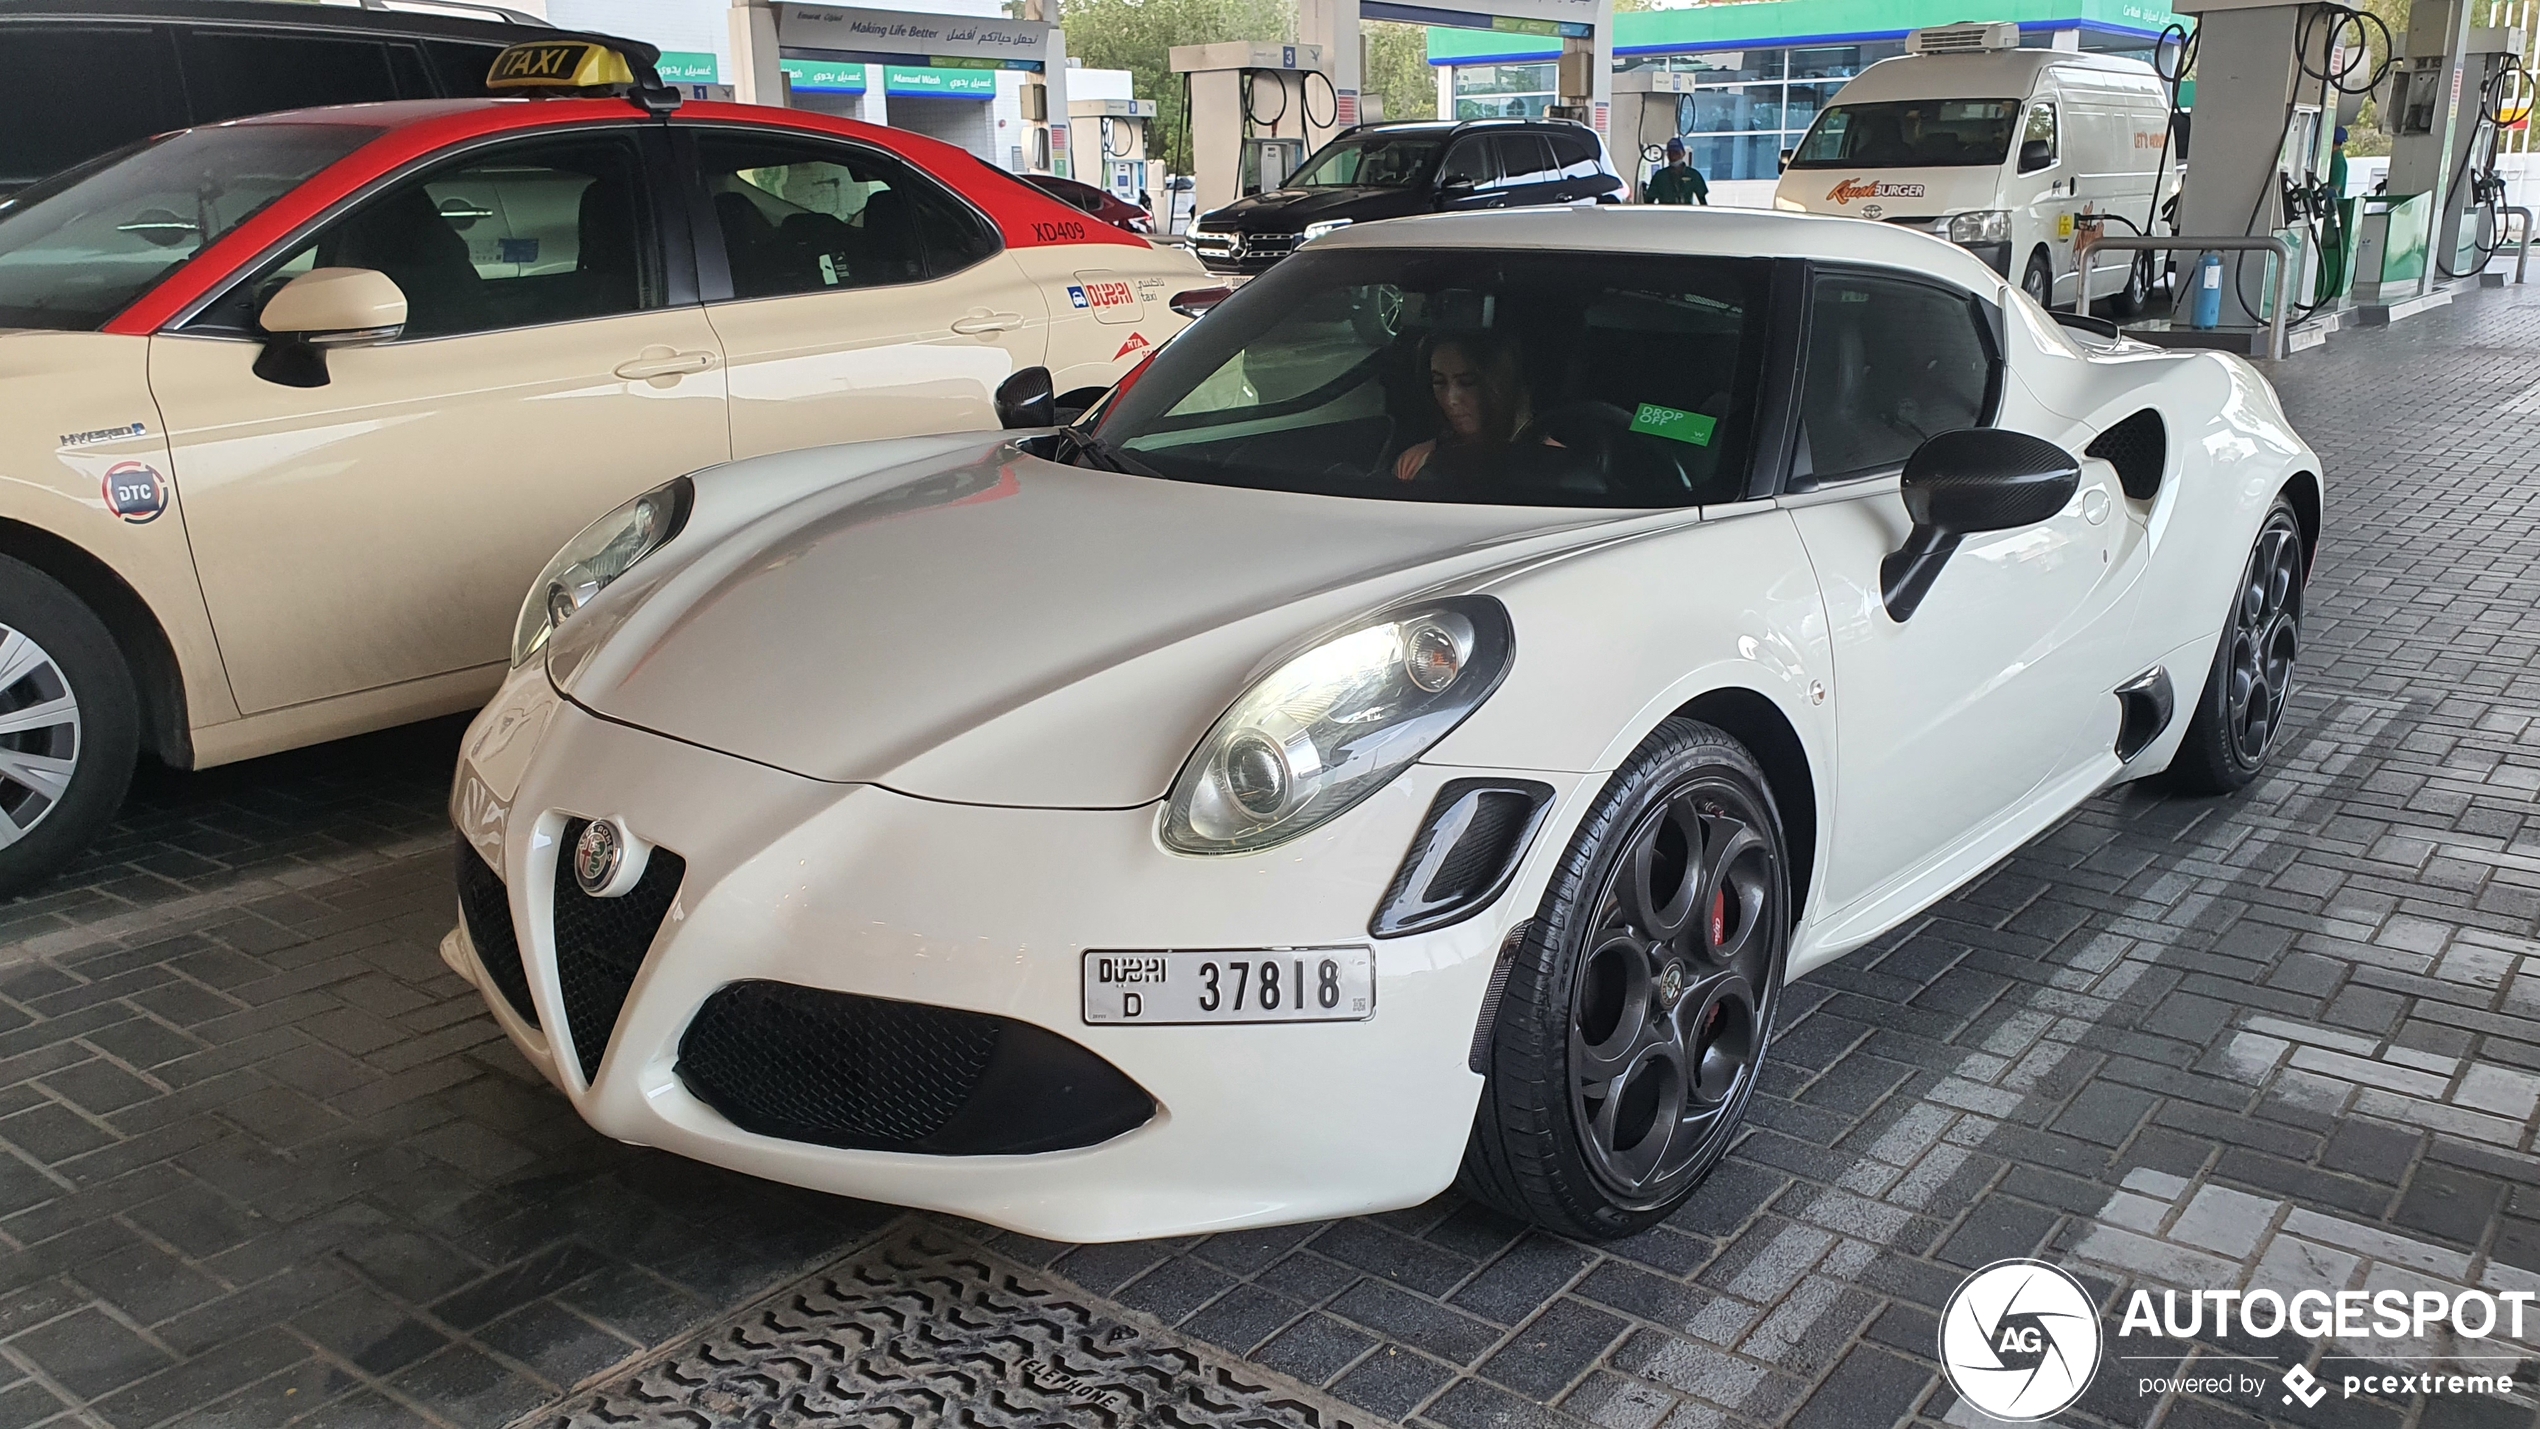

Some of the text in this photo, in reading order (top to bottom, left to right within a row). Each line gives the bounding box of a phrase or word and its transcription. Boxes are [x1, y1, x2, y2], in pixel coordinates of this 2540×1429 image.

[850, 21, 939, 39] Making Life Better
[946, 26, 1038, 46] نجعل حياتكم أفضل
[502, 49, 570, 76] TAXI
[1286, 51, 1293, 65] 3
[685, 64, 712, 77] غسيل
[837, 71, 861, 83] غسيل
[893, 73, 941, 85] Manual Wash
[970, 77, 992, 89] غسيل
[1031, 221, 1086, 242] XD409
[1141, 290, 1158, 302] taxi
[1127, 338, 1145, 349] RTA
[1639, 413, 1667, 426] OFF
[1642, 406, 1684, 421] DROP
[118, 484, 152, 501] DTC
[597, 825, 613, 862] ROMEO
[1100, 958, 1341, 1011] DUBAI 37818
[1124, 992, 1142, 1017] D
[1012, 1355, 1119, 1408] TELEPHONE
